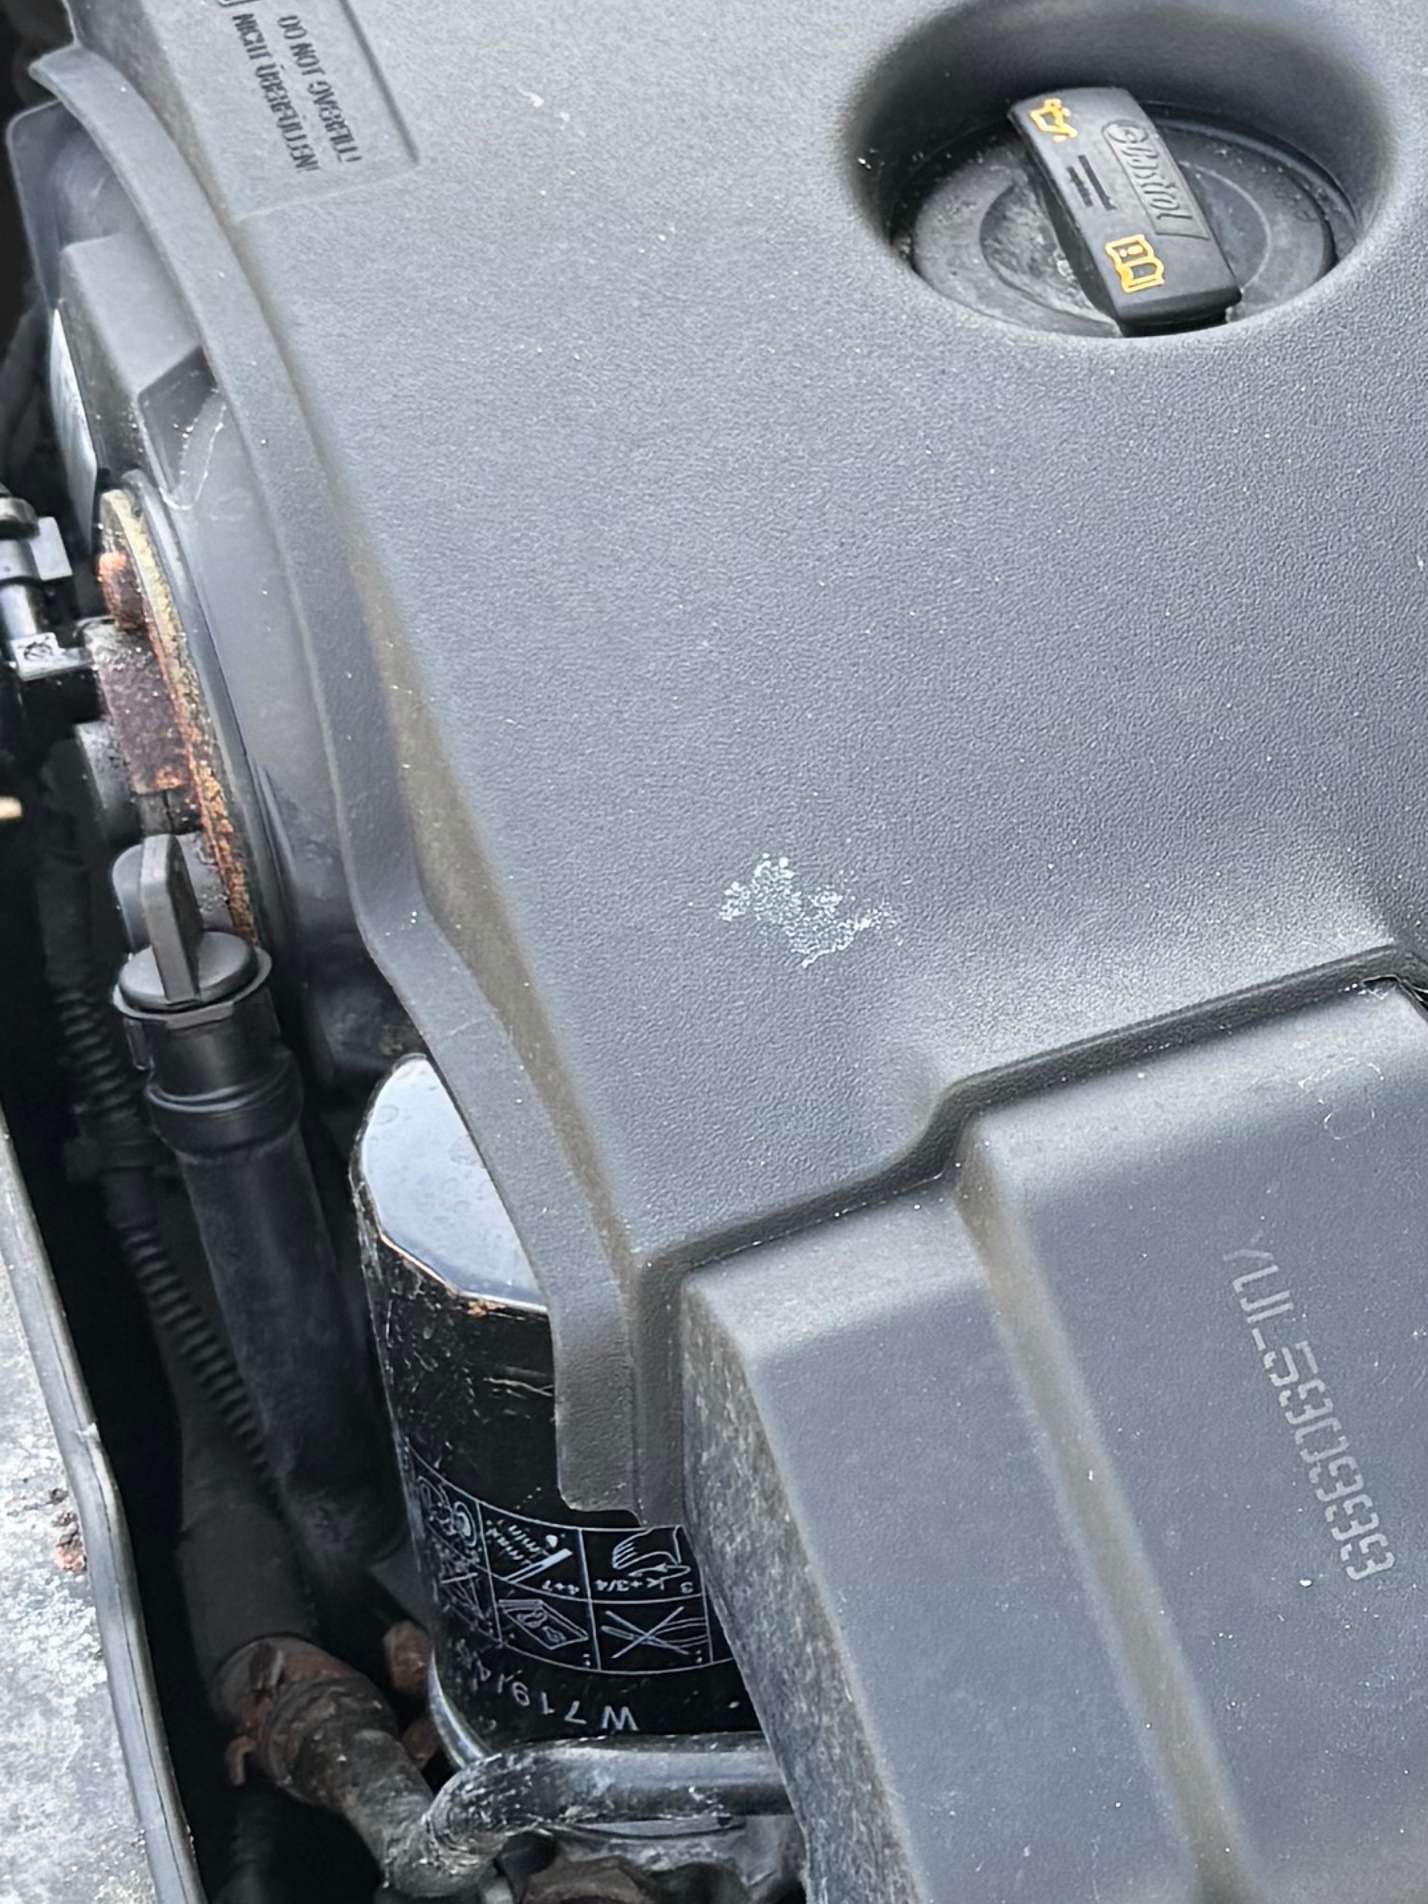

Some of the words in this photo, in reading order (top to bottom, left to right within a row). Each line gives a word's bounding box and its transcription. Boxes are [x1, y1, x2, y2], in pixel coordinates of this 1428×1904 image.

[231, 13, 272, 61] NICHT
[278, 14, 307, 39] DO
[289, 42, 325, 76] NOT
[1101, 118, 1196, 224] Castrol
[601, 1705, 639, 1731] W
